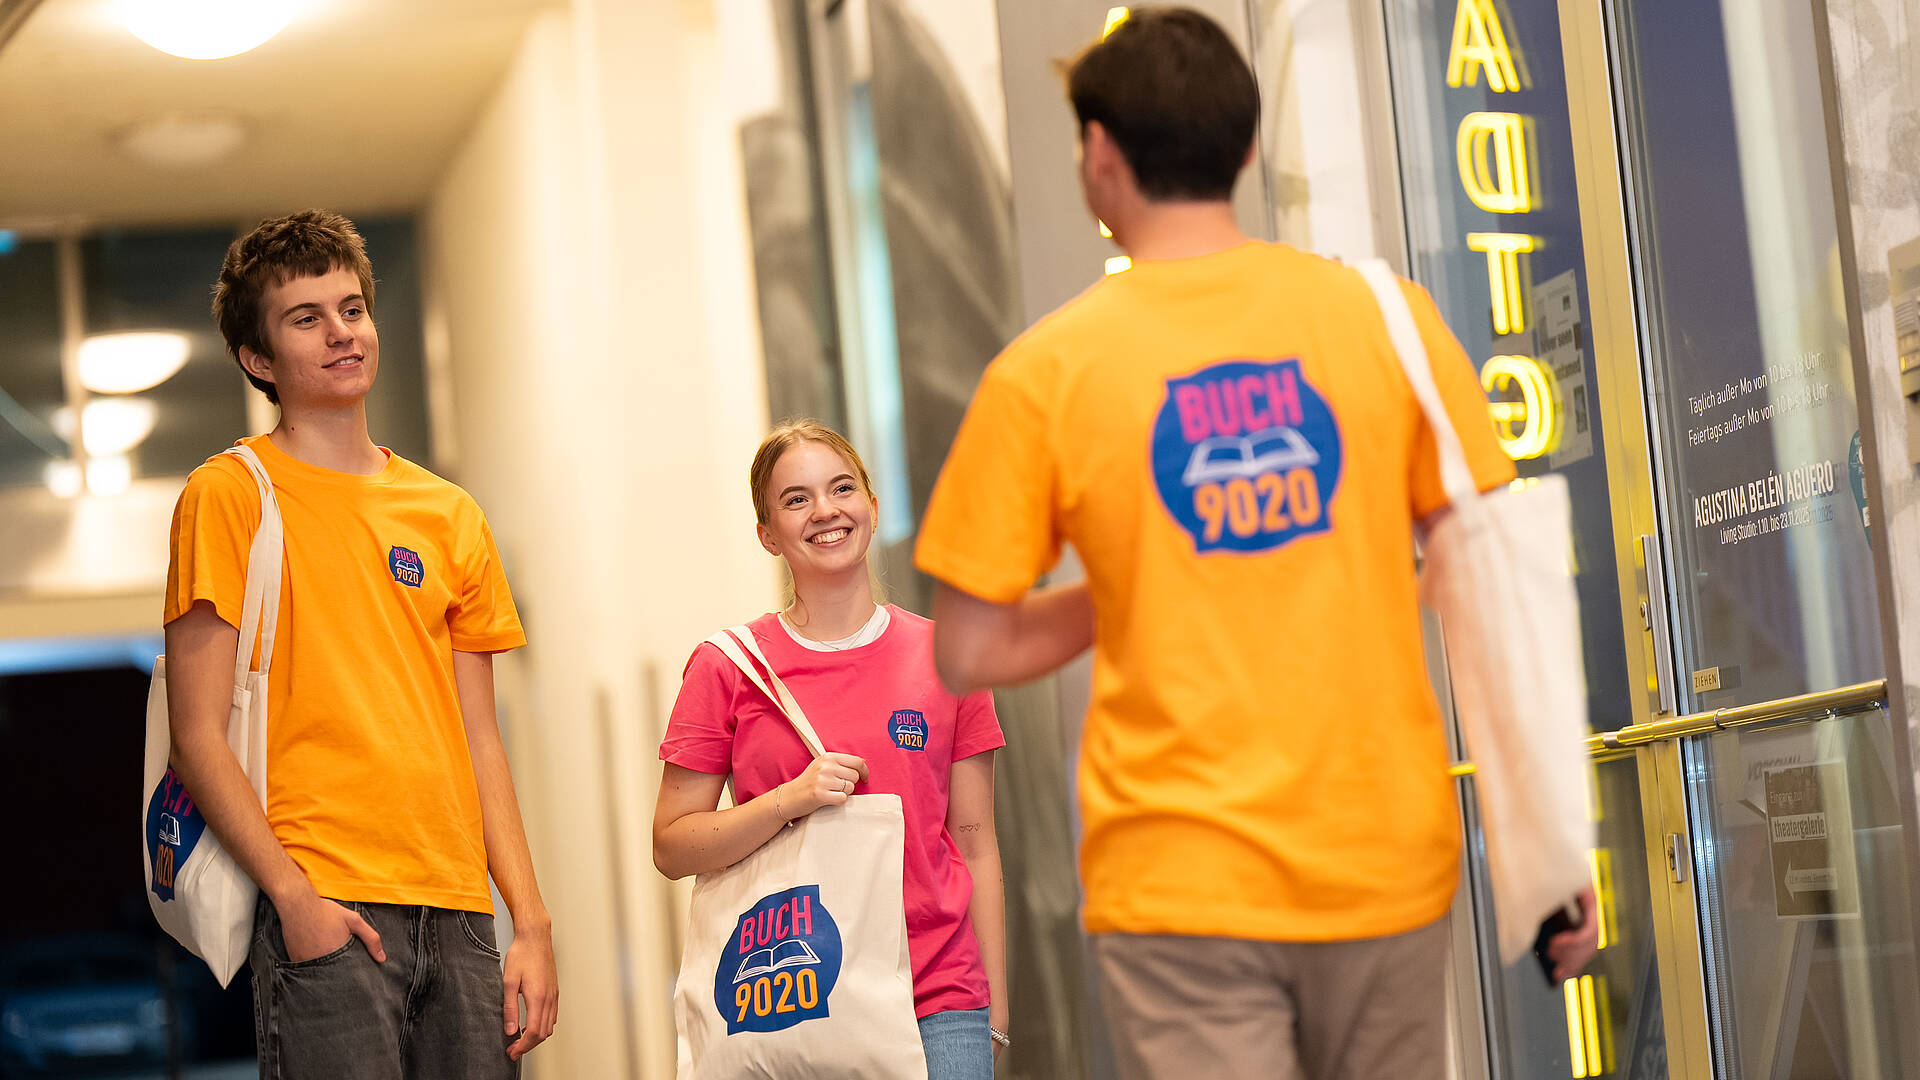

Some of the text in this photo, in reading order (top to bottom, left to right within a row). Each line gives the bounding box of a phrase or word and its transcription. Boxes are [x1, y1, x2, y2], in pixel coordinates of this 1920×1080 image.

[1688, 390, 1716, 417] Täglich
[1717, 383, 1739, 405] außer
[1739, 377, 1752, 396] Mo
[1753, 374, 1768, 390] von
[1804, 351, 1820, 370] Uhr
[1174, 368, 1304, 444] BUCH
[1688, 423, 1723, 447] Feiertags
[1724, 413, 1746, 435] außer
[1746, 407, 1760, 426] Mo
[1760, 403, 1775, 421] von
[1812, 382, 1829, 401] Uhr
[1192, 466, 1322, 543] 9020
[1695, 460, 1834, 529] AGUSTINA BELÉN AGÜERO
[1719, 526, 1738, 545] Living
[1737, 519, 1758, 541] Studio:
[1770, 513, 1780, 532] bis
[394, 548, 418, 564] BUCH
[396, 567, 419, 584] 9020
[1694, 673, 1718, 688] ZIEHEN
[895, 713, 922, 726] BUCH
[898, 733, 923, 748] 9020
[1774, 815, 1825, 839] theatergalerie
[738, 895, 813, 955] BUCH
[735, 968, 819, 1023] 9020
